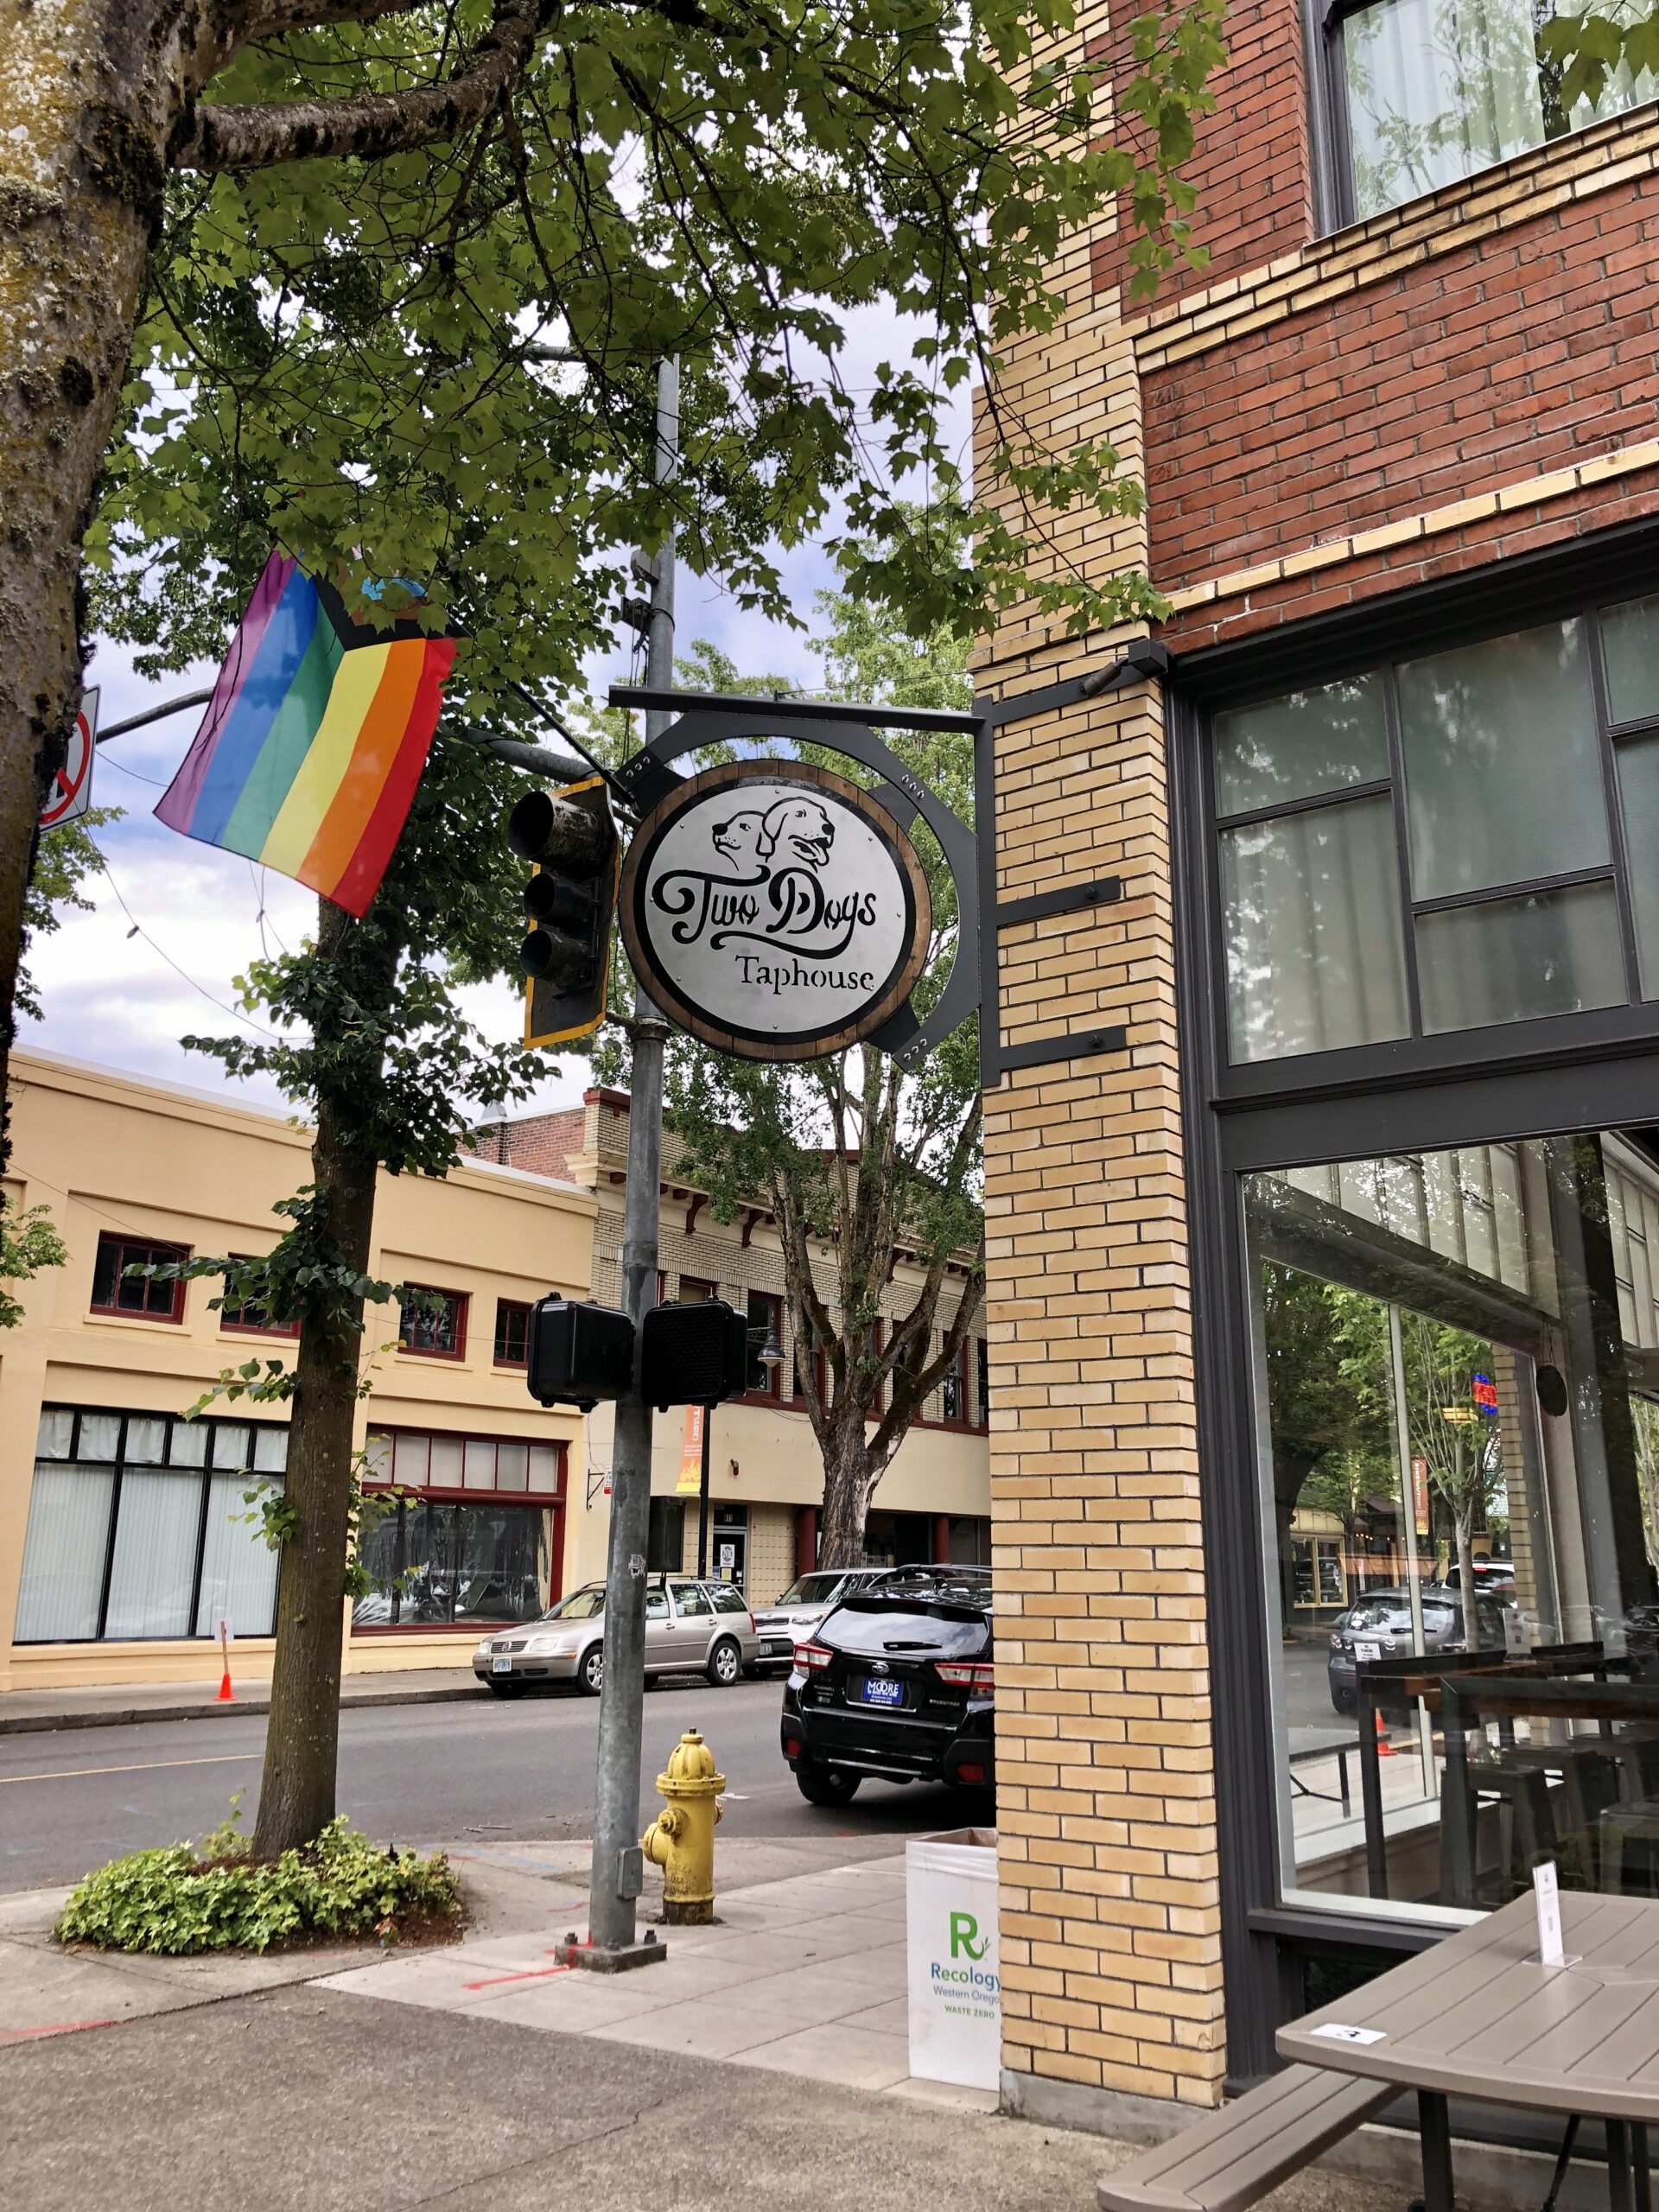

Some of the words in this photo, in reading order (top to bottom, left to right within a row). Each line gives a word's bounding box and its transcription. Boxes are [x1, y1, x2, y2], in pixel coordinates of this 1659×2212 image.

[652, 865, 771, 944] Two
[710, 867, 876, 959] Dogs
[735, 955, 874, 995] Taphouse
[867, 1680, 899, 1694] MOORE
[931, 1962, 1001, 1993] Recology
[933, 1985, 969, 1999] Western
[971, 1990, 1000, 2005] Orego
[944, 2005, 971, 2016] WASTE
[974, 2009, 995, 2019] ZERO
